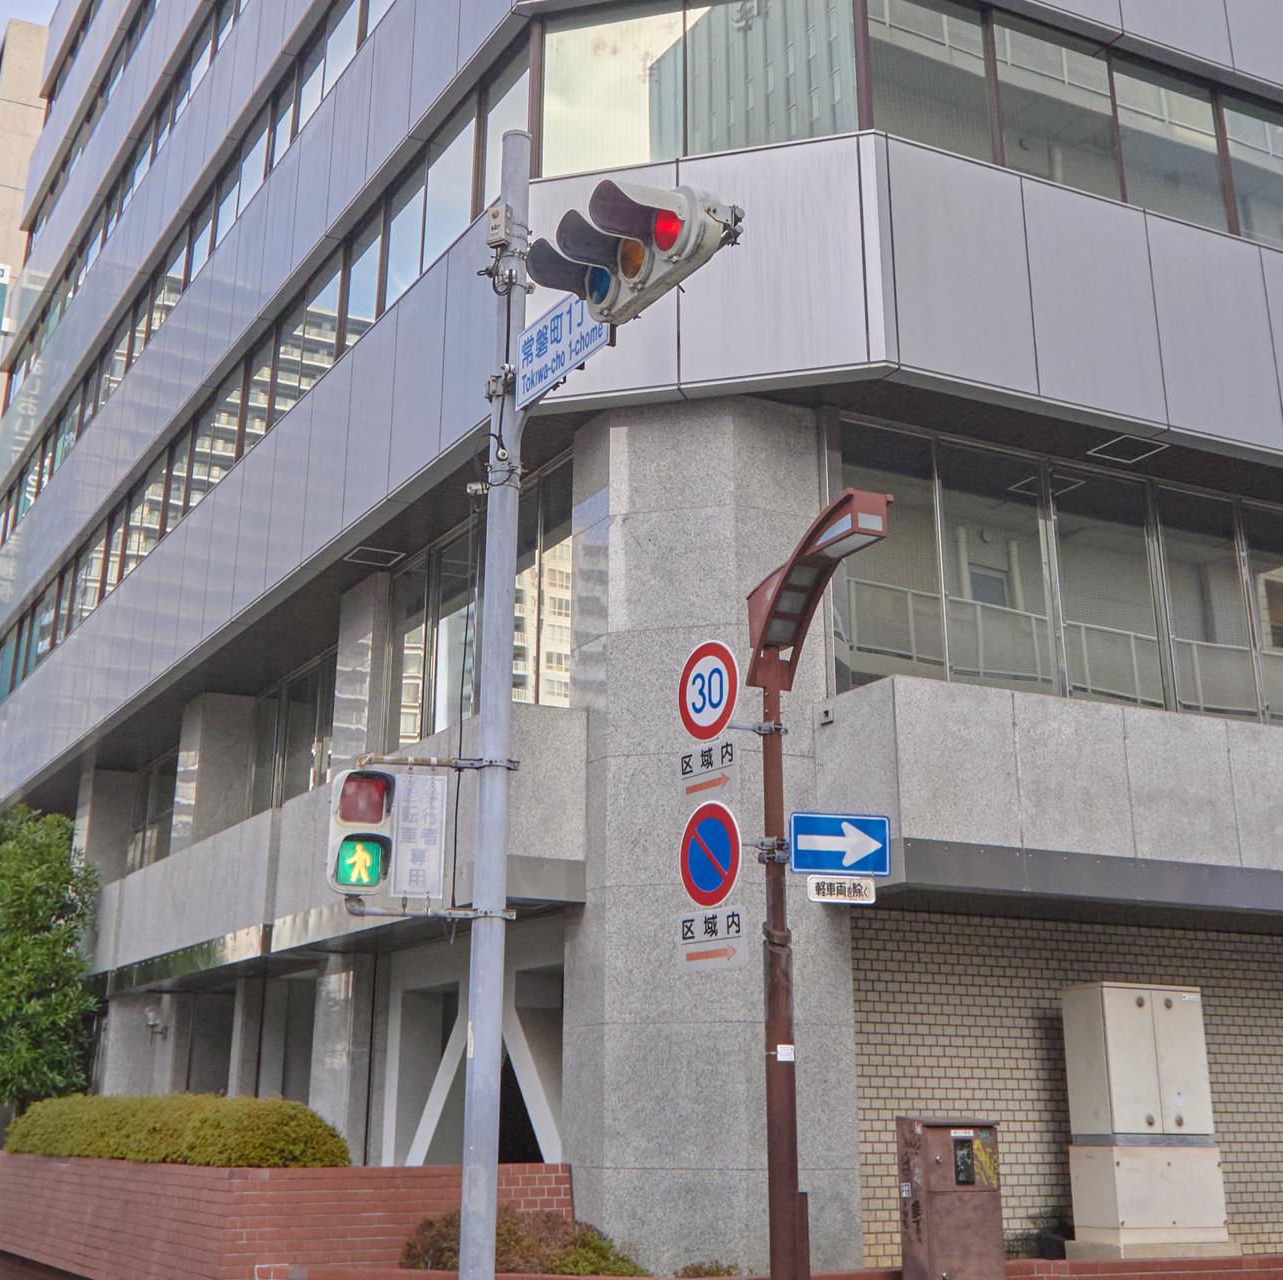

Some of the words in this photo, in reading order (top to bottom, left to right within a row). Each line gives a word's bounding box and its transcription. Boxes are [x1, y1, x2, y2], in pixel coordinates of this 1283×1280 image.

[521, 350, 566, 395] Tokiwa-cho
[568, 321, 604, 361] 1-chome
[691, 667, 724, 714] 30
[681, 742, 734, 776] 区域内
[815, 881, 870, 900] 軽車両を除く
[681, 911, 741, 941] 区域内
